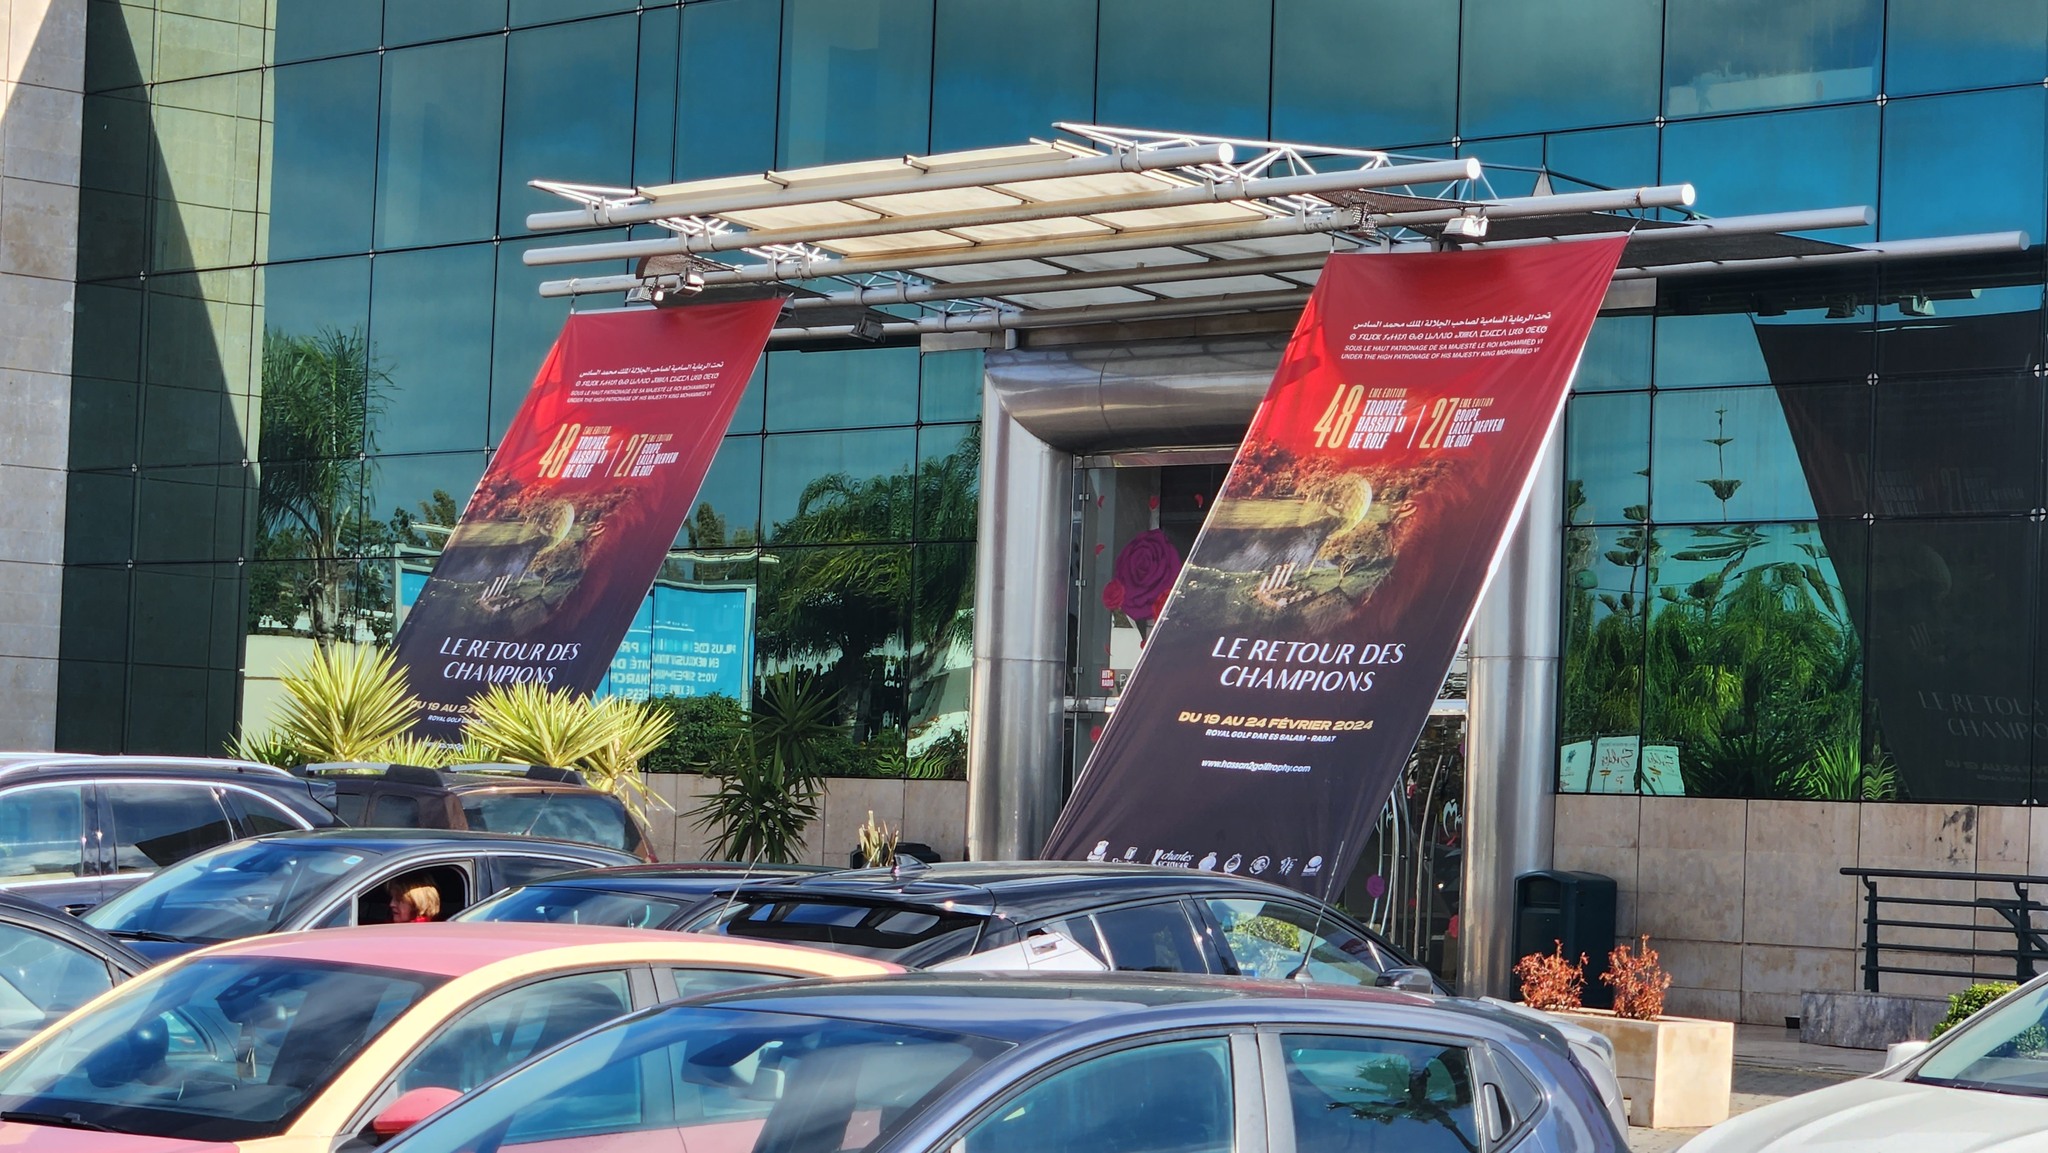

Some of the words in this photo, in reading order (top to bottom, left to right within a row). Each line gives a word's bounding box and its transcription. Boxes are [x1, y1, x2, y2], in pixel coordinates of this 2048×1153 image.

[1480, 315, 1508, 326] السامية
[1509, 314, 1534, 325] الرعاية
[1534, 312, 1551, 320] تحت
[1353, 321, 1382, 330] السادس
[1425, 320, 1451, 329] الجلالة
[1448, 342, 1477, 350] MAJESTÉ
[1499, 339, 1536, 347] MOHAMMED
[1496, 347, 1533, 356] MOHAMMED
[1382, 388, 1408, 398] EDITION
[1313, 384, 1365, 449] 48
[1454, 408, 1482, 422] COUPE
[1355, 416, 1396, 432] HASSAN
[1395, 416, 1408, 432] II
[1419, 398, 1460, 449] 27
[1448, 421, 1473, 435] LALLA
[1472, 418, 1506, 434] MERYEM
[1348, 432, 1362, 449] DE
[1362, 432, 1390, 449] GOLF
[1443, 435, 1455, 448] DE
[1454, 434, 1475, 448] GOLF
[538, 423, 581, 478] 48
[613, 434, 648, 477] 27
[440, 637, 468, 655] LE
[466, 639, 545, 660] RETOUR
[546, 642, 581, 661] DES
[1211, 637, 1248, 659] LE
[1248, 639, 1355, 665] RETOUR
[1358, 643, 1406, 665] DES
[443, 661, 557, 684] CHAMPIONS
[1220, 665, 1375, 692] CHAMPIONS
[427, 702, 440, 711] 19
[440, 704, 458, 713] AU
[428, 714, 446, 722] ROYAL
[1178, 711, 1202, 723] DU
[1203, 713, 1220, 725] 19
[1221, 715, 1245, 726] AU
[1245, 717, 1266, 728] 24
[1268, 717, 1332, 730] FÉVRIER
[1332, 720, 1374, 731] 2024
[1205, 729, 1230, 738] ROYAL
[1231, 730, 1252, 739] GOLF
[1251, 732, 1268, 740] DAR
[1269, 732, 1279, 741] ES
[1279, 733, 1306, 742] SALAM
[1311, 735, 1337, 743] RABAT
